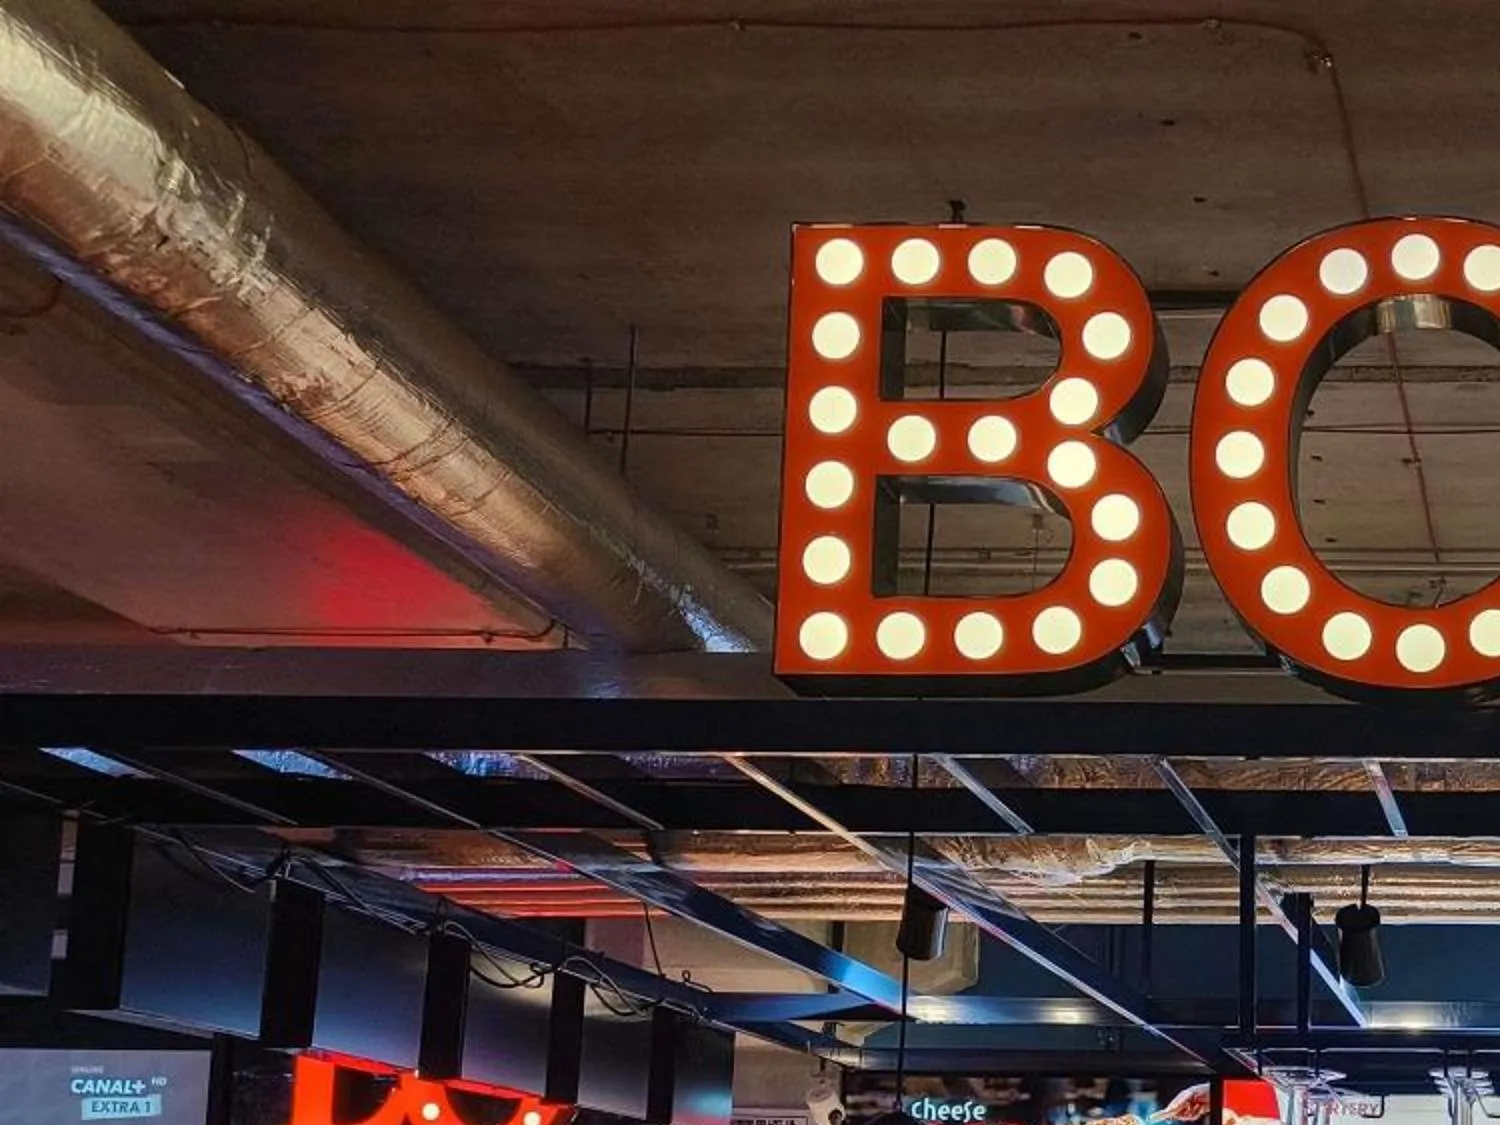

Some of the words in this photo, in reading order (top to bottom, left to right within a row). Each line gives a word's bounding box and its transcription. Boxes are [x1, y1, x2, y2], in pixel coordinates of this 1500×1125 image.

[71, 1078, 146, 1095] CANAL+
[91, 1100, 140, 1113] EXTRA
[144, 1101, 152, 1113] 1
[911, 1097, 987, 1123] cheese
